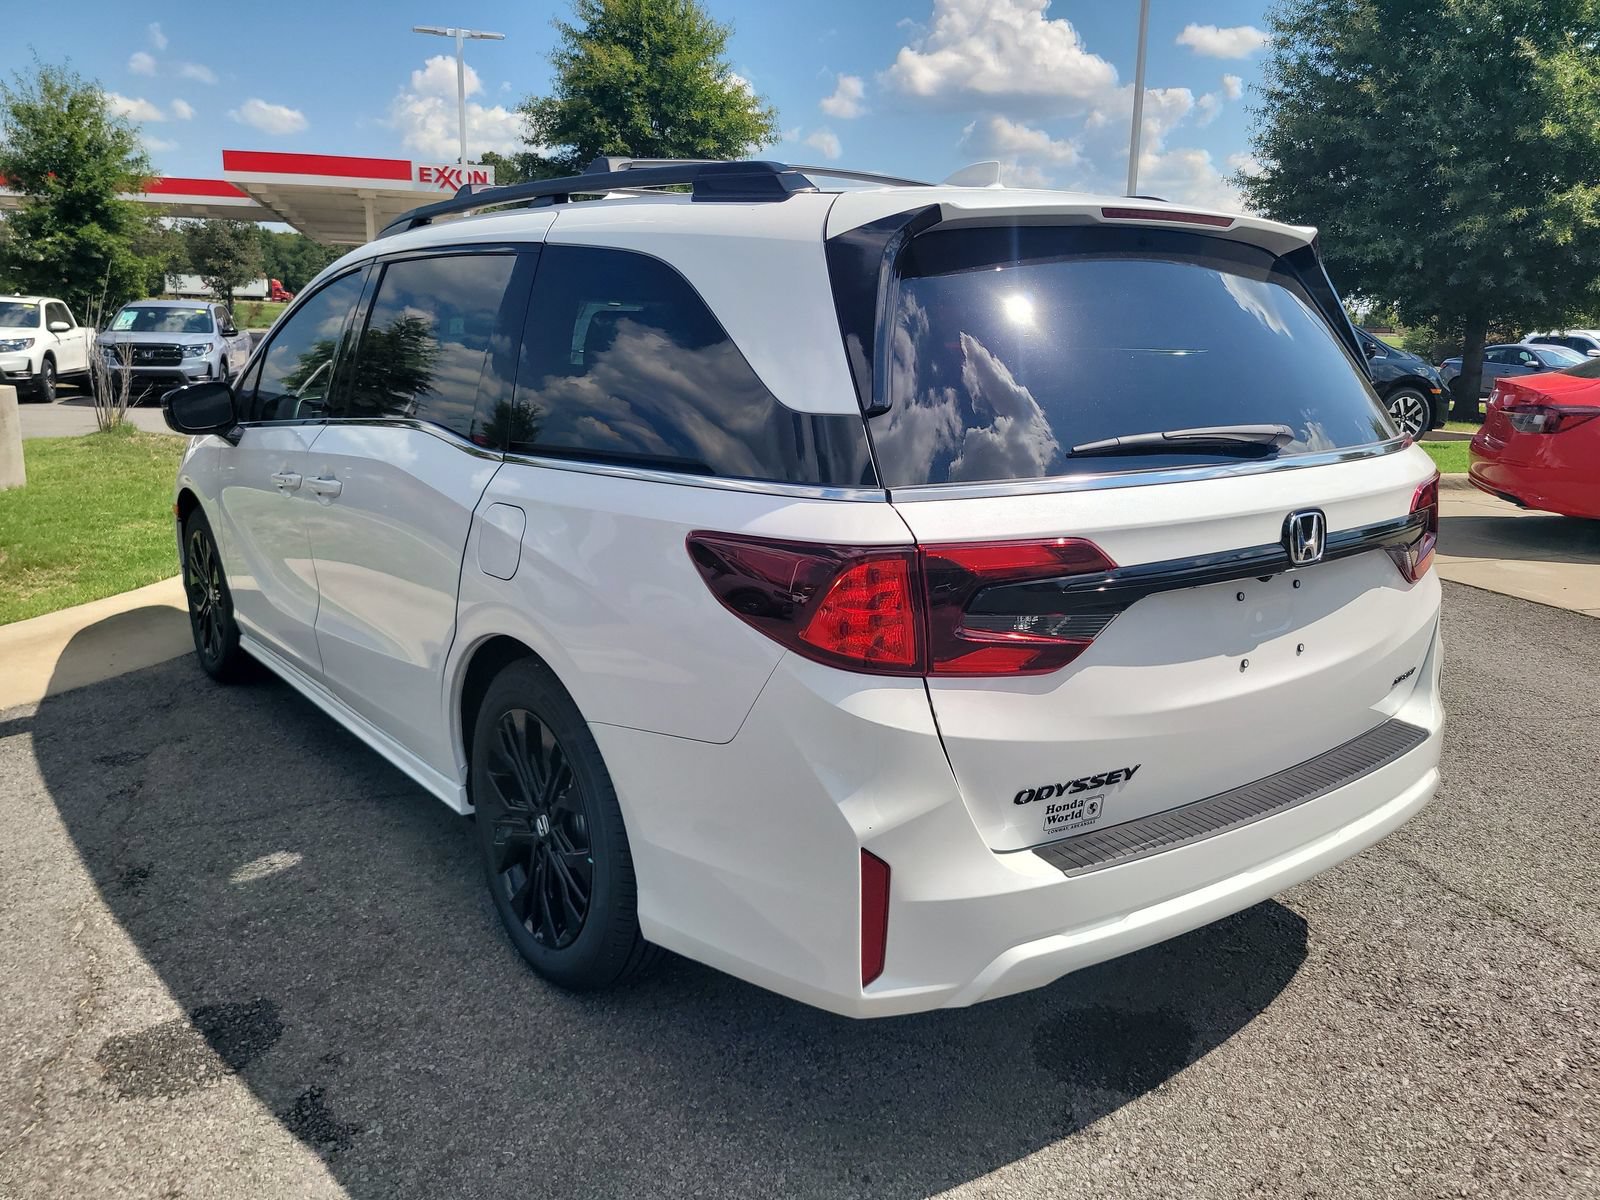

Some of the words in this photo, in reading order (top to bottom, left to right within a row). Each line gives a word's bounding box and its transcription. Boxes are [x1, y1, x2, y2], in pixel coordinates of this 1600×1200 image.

[418, 165, 488, 192] EXXON
[1013, 764, 1141, 805] ODYSSEY
[1045, 799, 1084, 815] Honda
[1046, 809, 1083, 825] World
